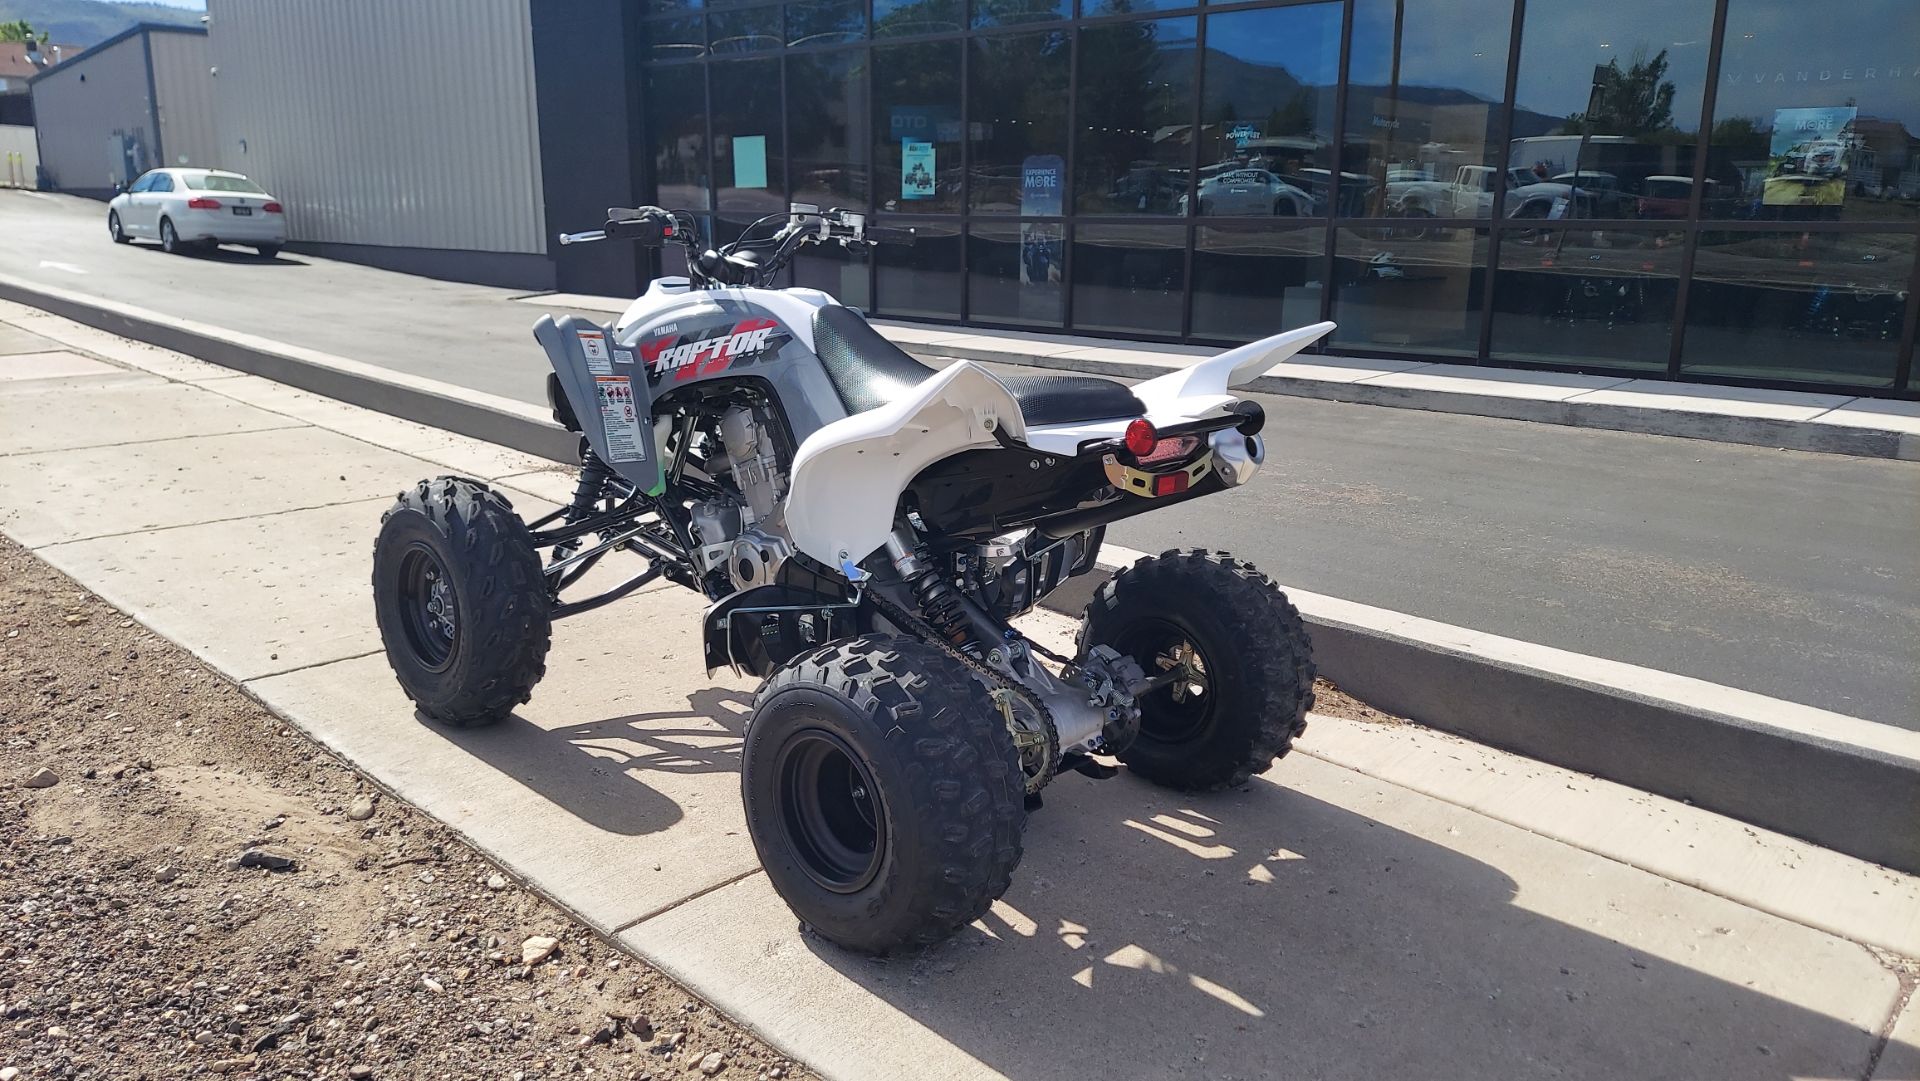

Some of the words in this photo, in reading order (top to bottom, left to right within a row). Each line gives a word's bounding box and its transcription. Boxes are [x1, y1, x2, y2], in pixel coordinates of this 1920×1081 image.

[1794, 120, 1833, 130] MORE
[1025, 168, 1056, 176] EXPERIENCE
[1025, 175, 1056, 188] MORE
[653, 322, 678, 337] YAMAHA
[655, 327, 774, 373] RAPTOR
